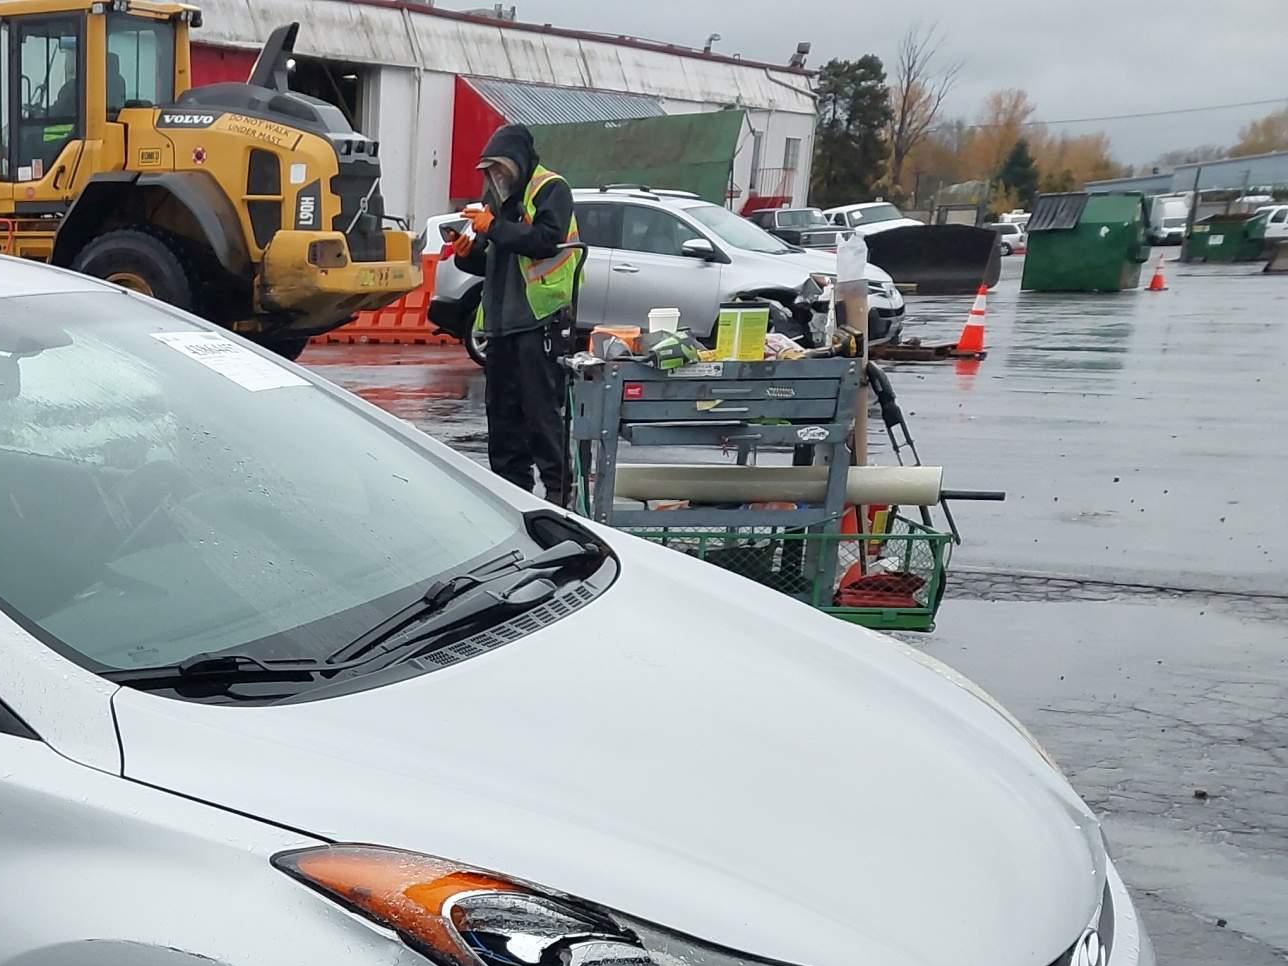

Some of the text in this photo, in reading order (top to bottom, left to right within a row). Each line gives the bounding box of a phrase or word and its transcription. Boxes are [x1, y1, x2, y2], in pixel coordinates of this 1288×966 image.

[163, 114, 214, 124] VOLVO
[229, 114, 290, 137] DO NOT WALK
[229, 124, 282, 145] UNDER MAST
[298, 196, 315, 225] L90H
